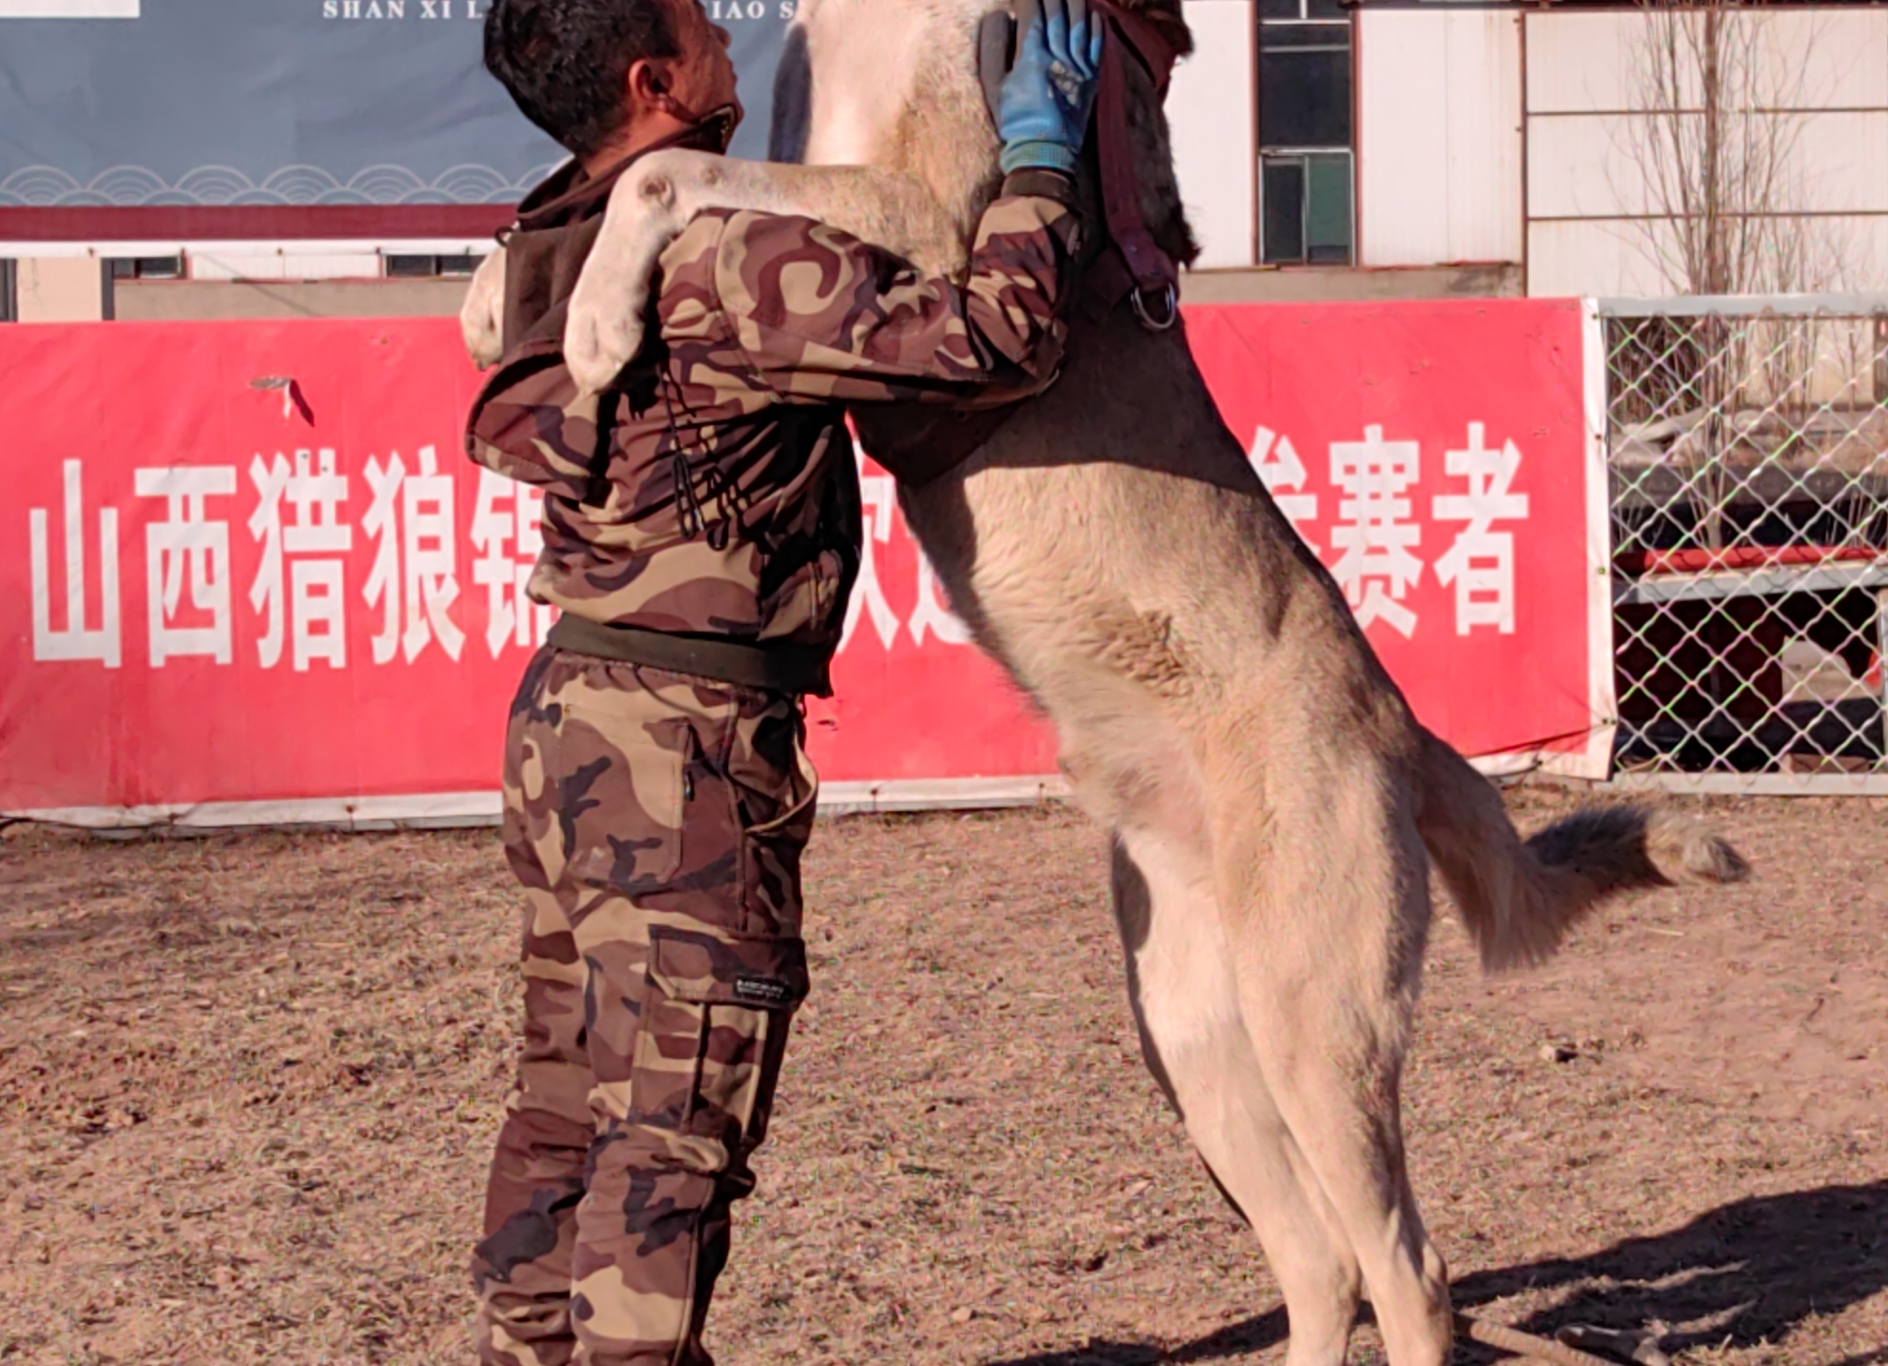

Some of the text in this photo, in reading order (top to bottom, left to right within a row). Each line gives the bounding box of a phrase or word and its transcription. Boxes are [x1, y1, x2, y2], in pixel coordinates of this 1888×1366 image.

[322, 0, 405, 19] SHAN
[420, 0, 452, 19] XI
[702, 0, 765, 20] IAO
